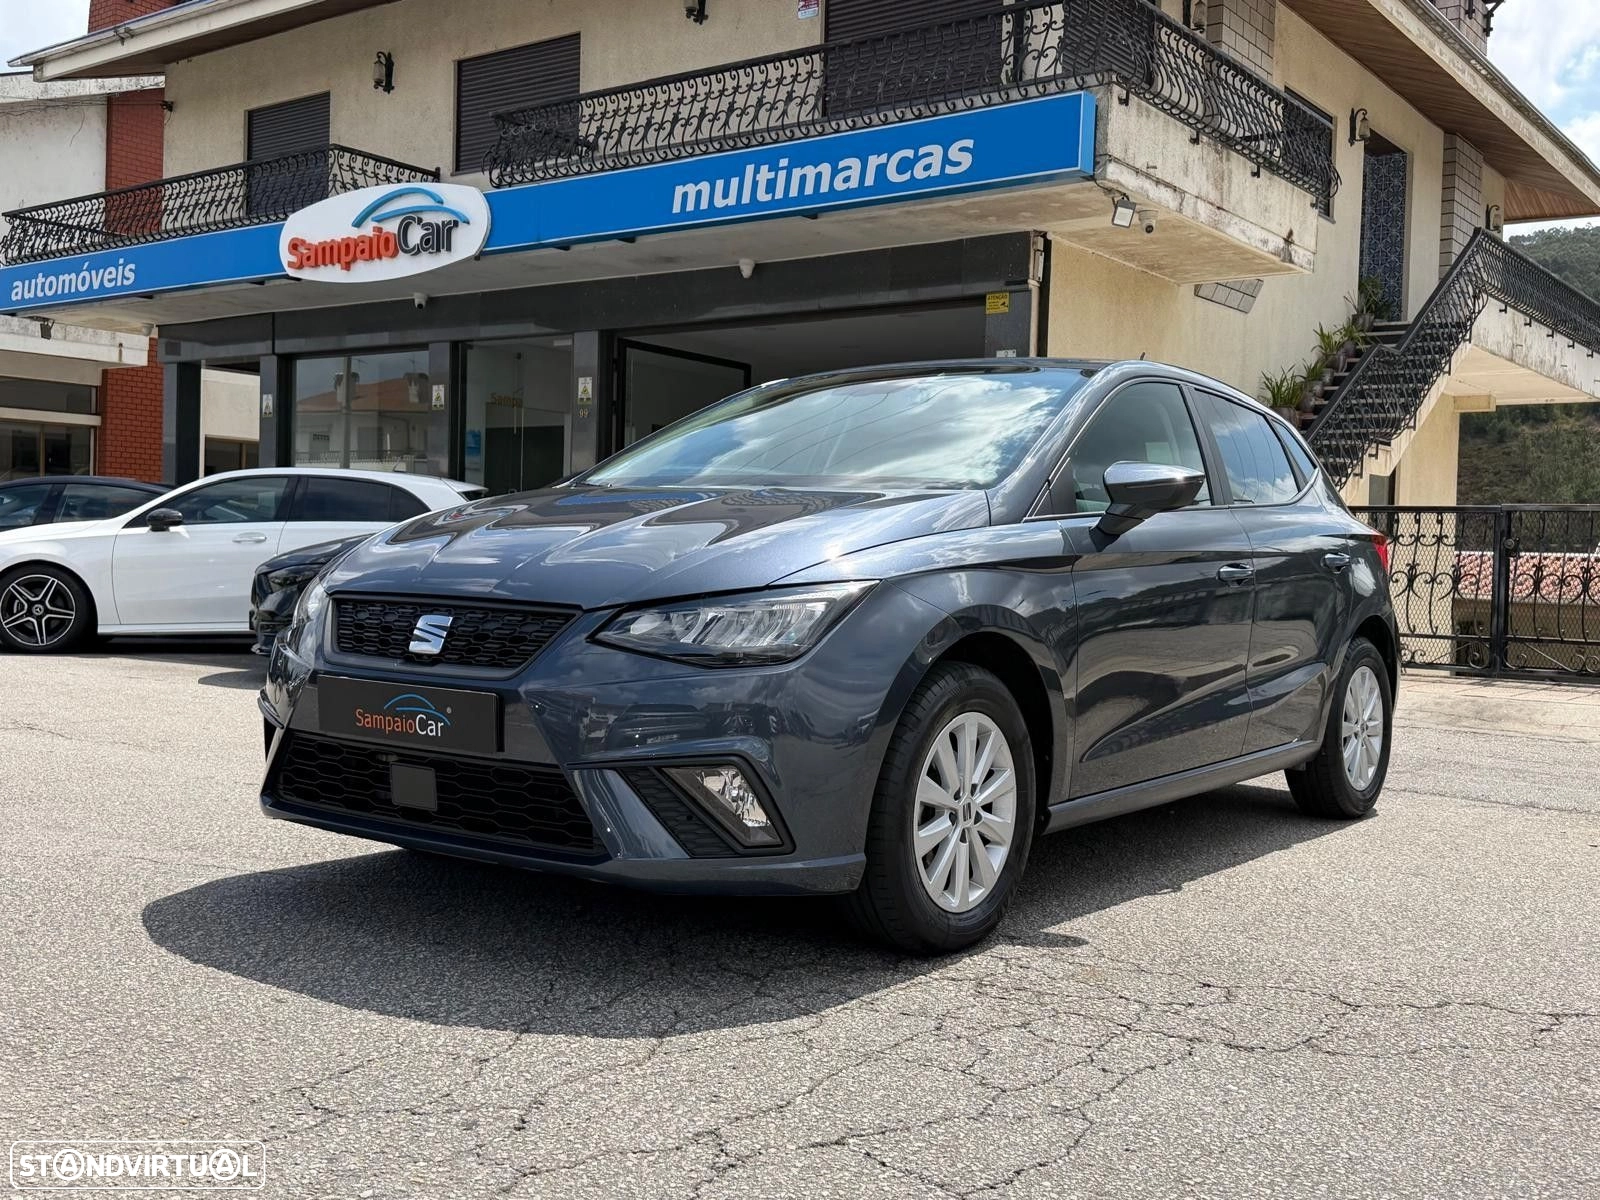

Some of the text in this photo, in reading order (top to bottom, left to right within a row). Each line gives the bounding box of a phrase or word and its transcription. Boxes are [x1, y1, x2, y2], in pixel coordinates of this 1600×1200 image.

[672, 139, 974, 214] multimarcas
[287, 215, 459, 271] SampaioCar
[11, 258, 136, 301] automóveis
[355, 708, 444, 736] SampaioCar
